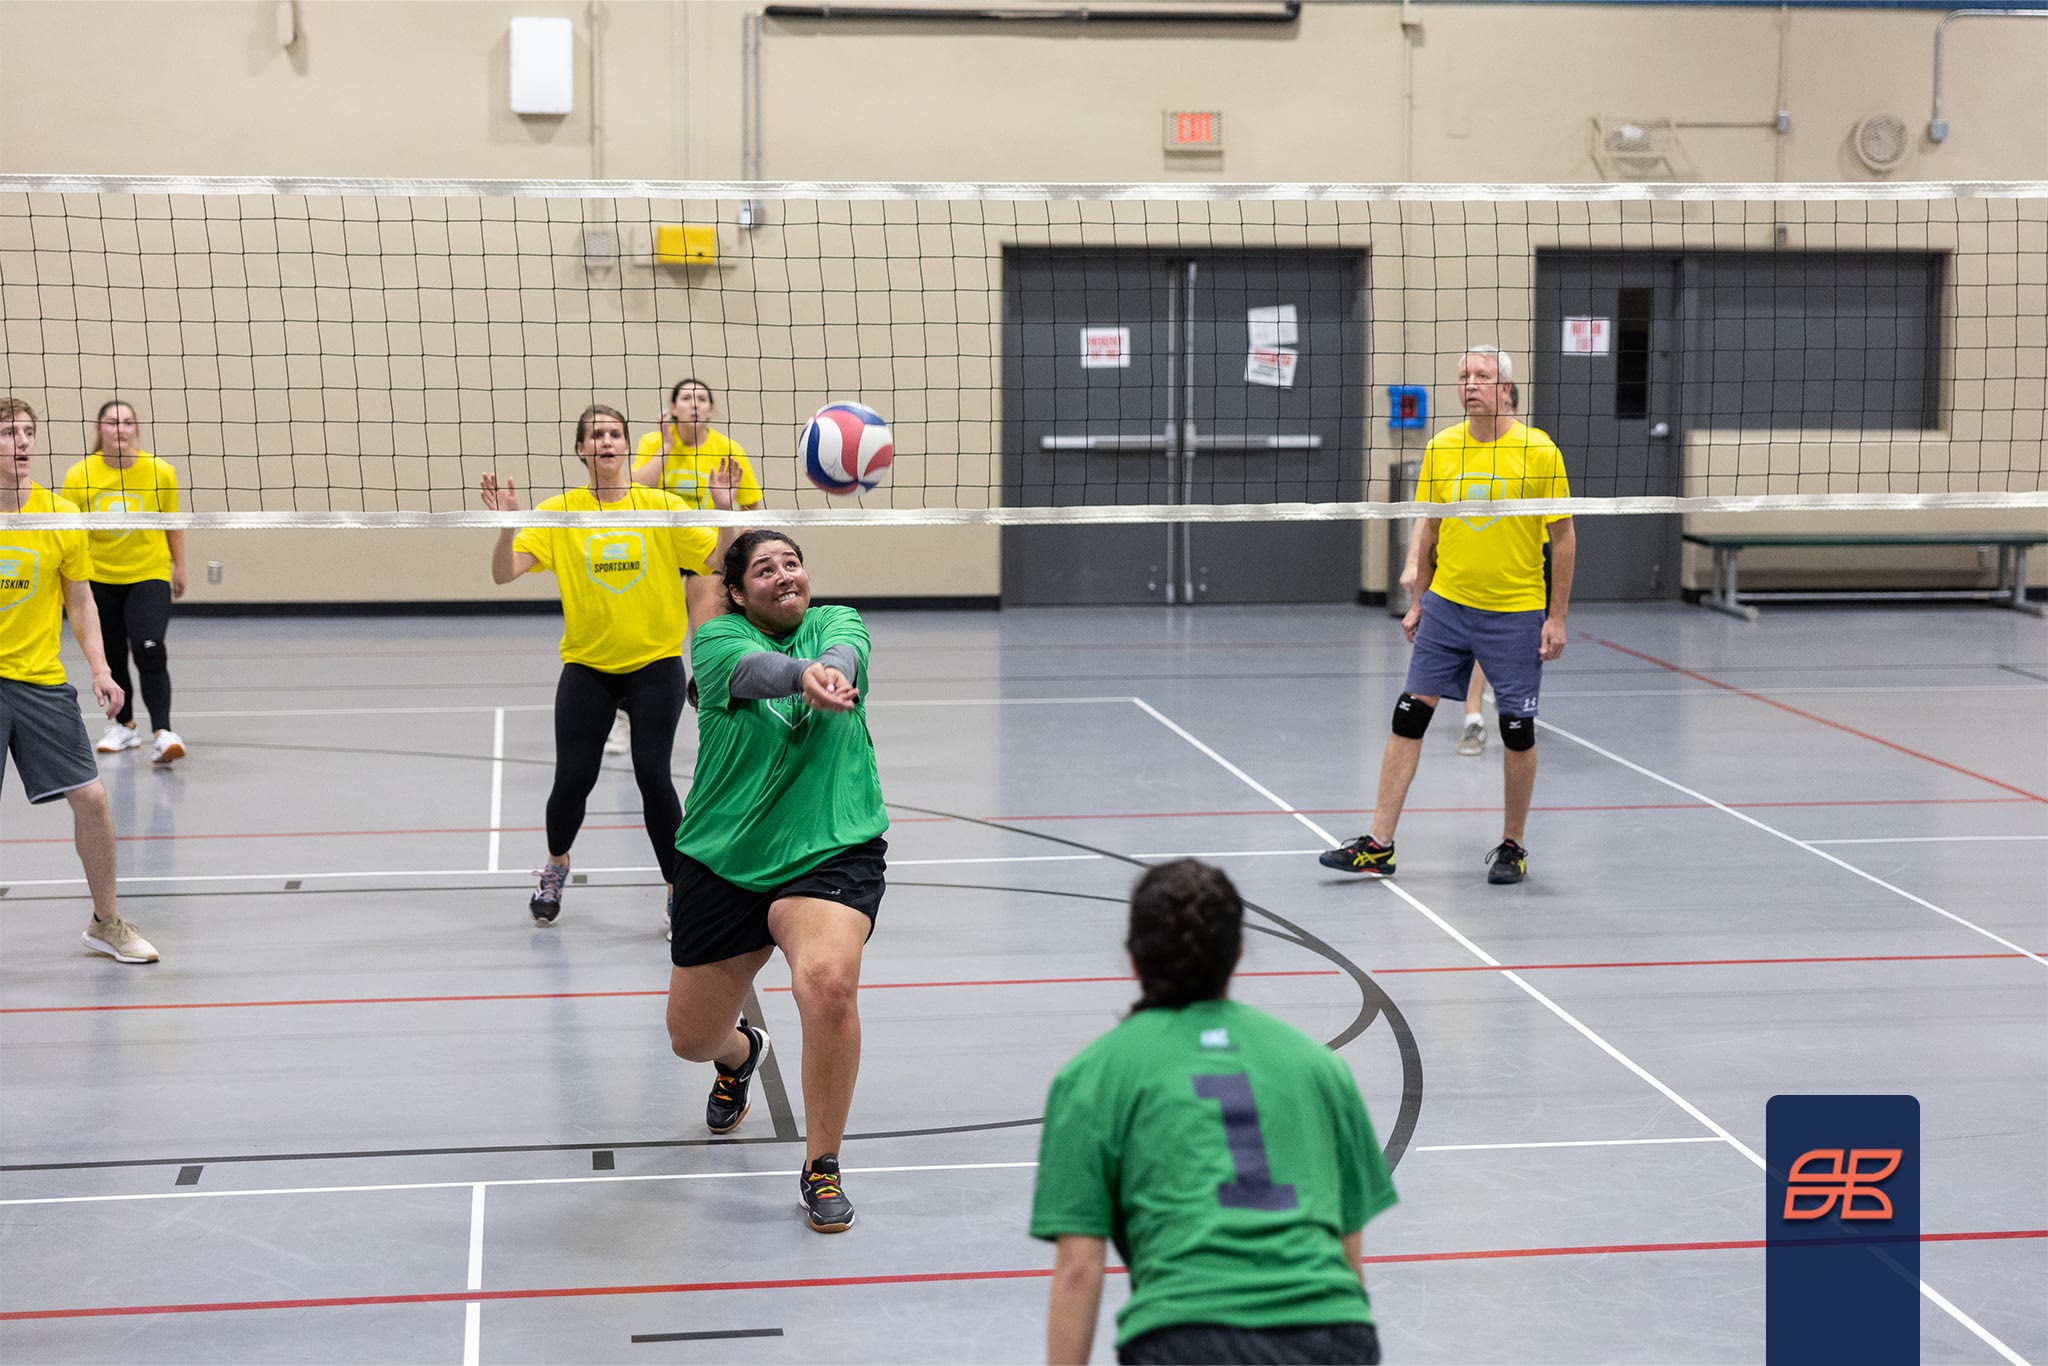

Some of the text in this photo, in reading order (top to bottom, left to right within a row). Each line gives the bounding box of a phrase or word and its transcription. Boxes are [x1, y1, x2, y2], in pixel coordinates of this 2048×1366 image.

[1177, 113, 1212, 142] EXIT
[594, 560, 640, 573] SPORTSKIND
[1191, 1071, 1299, 1212] 1
